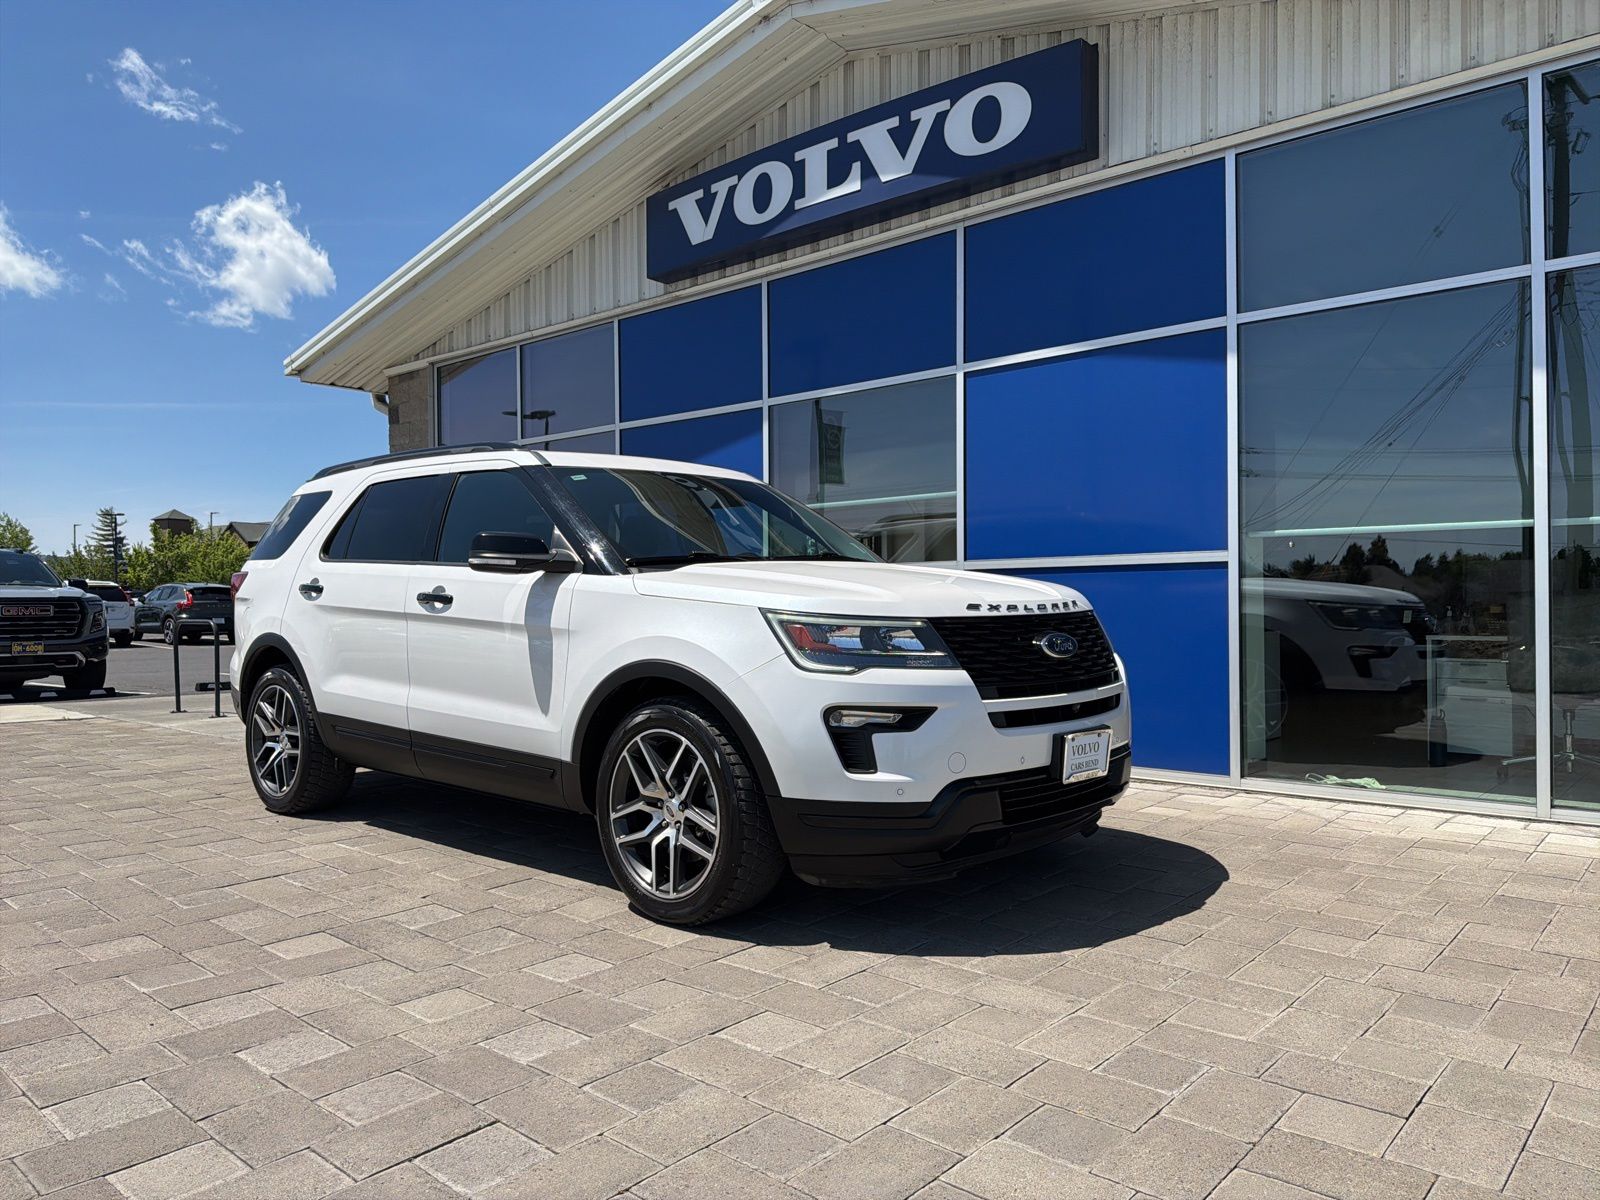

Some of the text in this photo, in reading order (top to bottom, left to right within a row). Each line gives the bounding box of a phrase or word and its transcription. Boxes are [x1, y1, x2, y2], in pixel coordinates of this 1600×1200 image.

[668, 81, 1032, 246] VOLVO
[2, 606, 51, 616] GMC
[966, 600, 1080, 612] EXPLORER
[1071, 741, 1100, 757] VOLVO
[1070, 759, 1099, 771] CARS BEND
